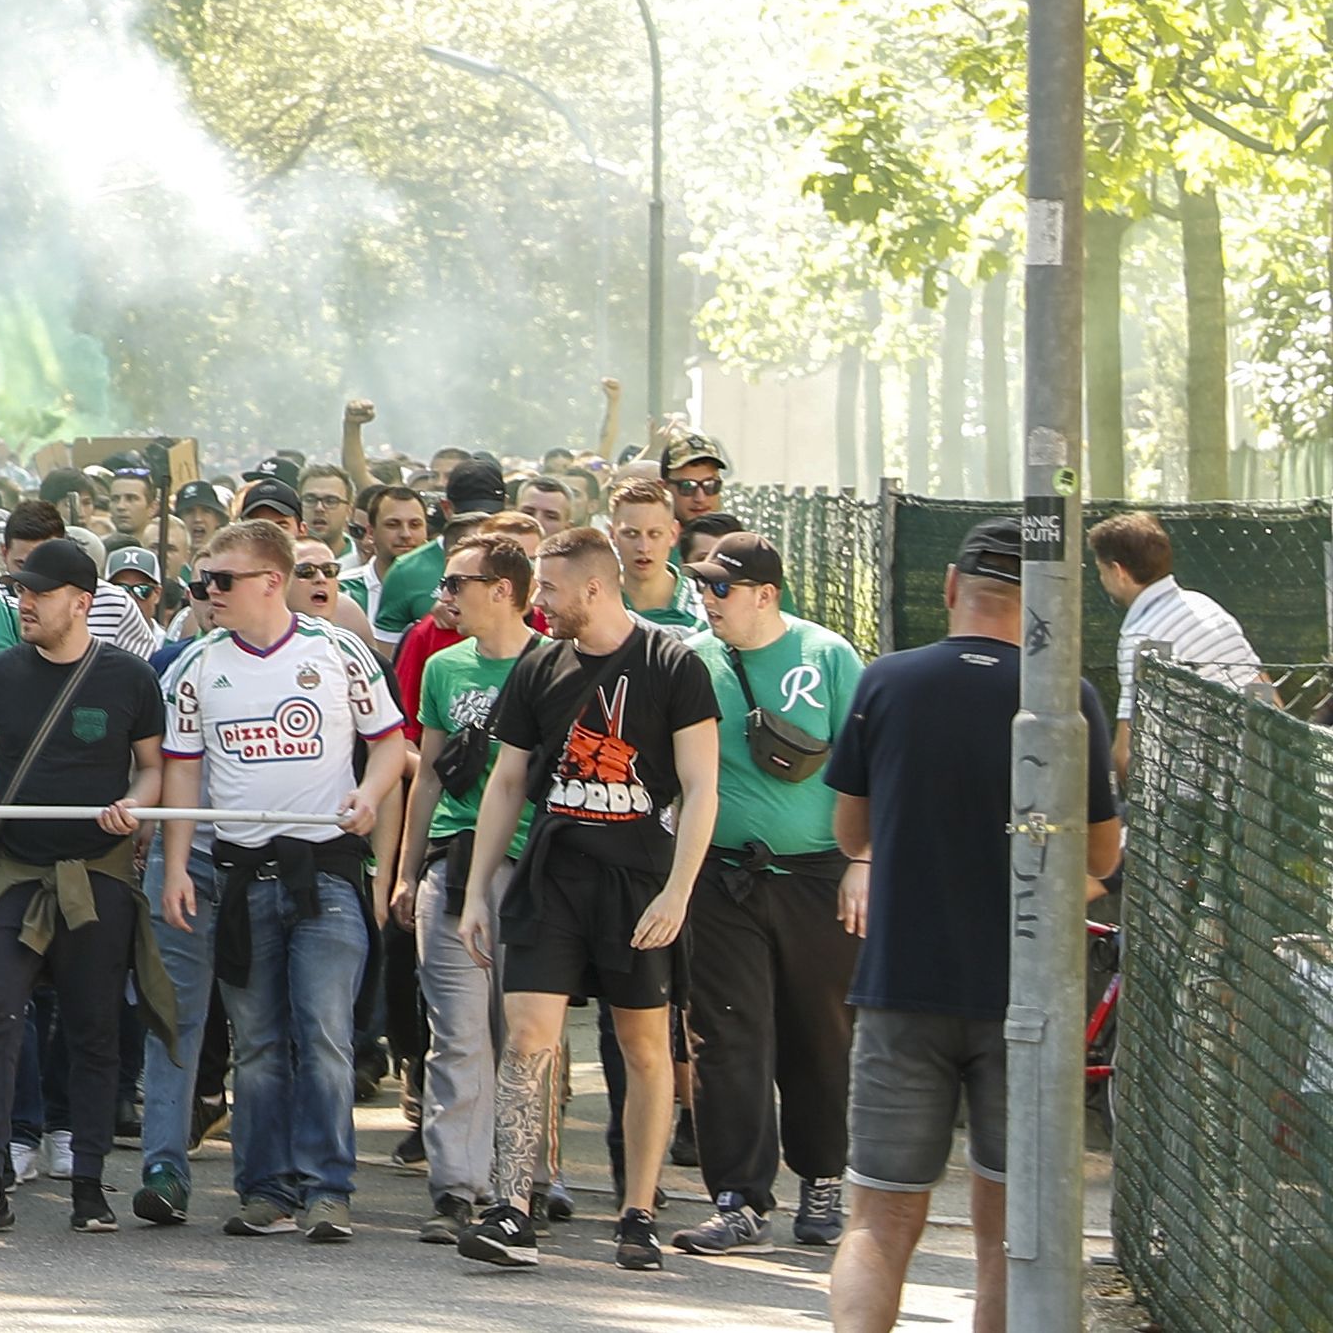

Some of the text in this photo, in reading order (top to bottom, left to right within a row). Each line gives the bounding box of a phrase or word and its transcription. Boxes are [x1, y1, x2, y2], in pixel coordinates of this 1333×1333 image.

[780, 665, 825, 712] R
[224, 723, 279, 747] pizza
[243, 738, 318, 758] on tour
[499, 1218, 520, 1235] N
